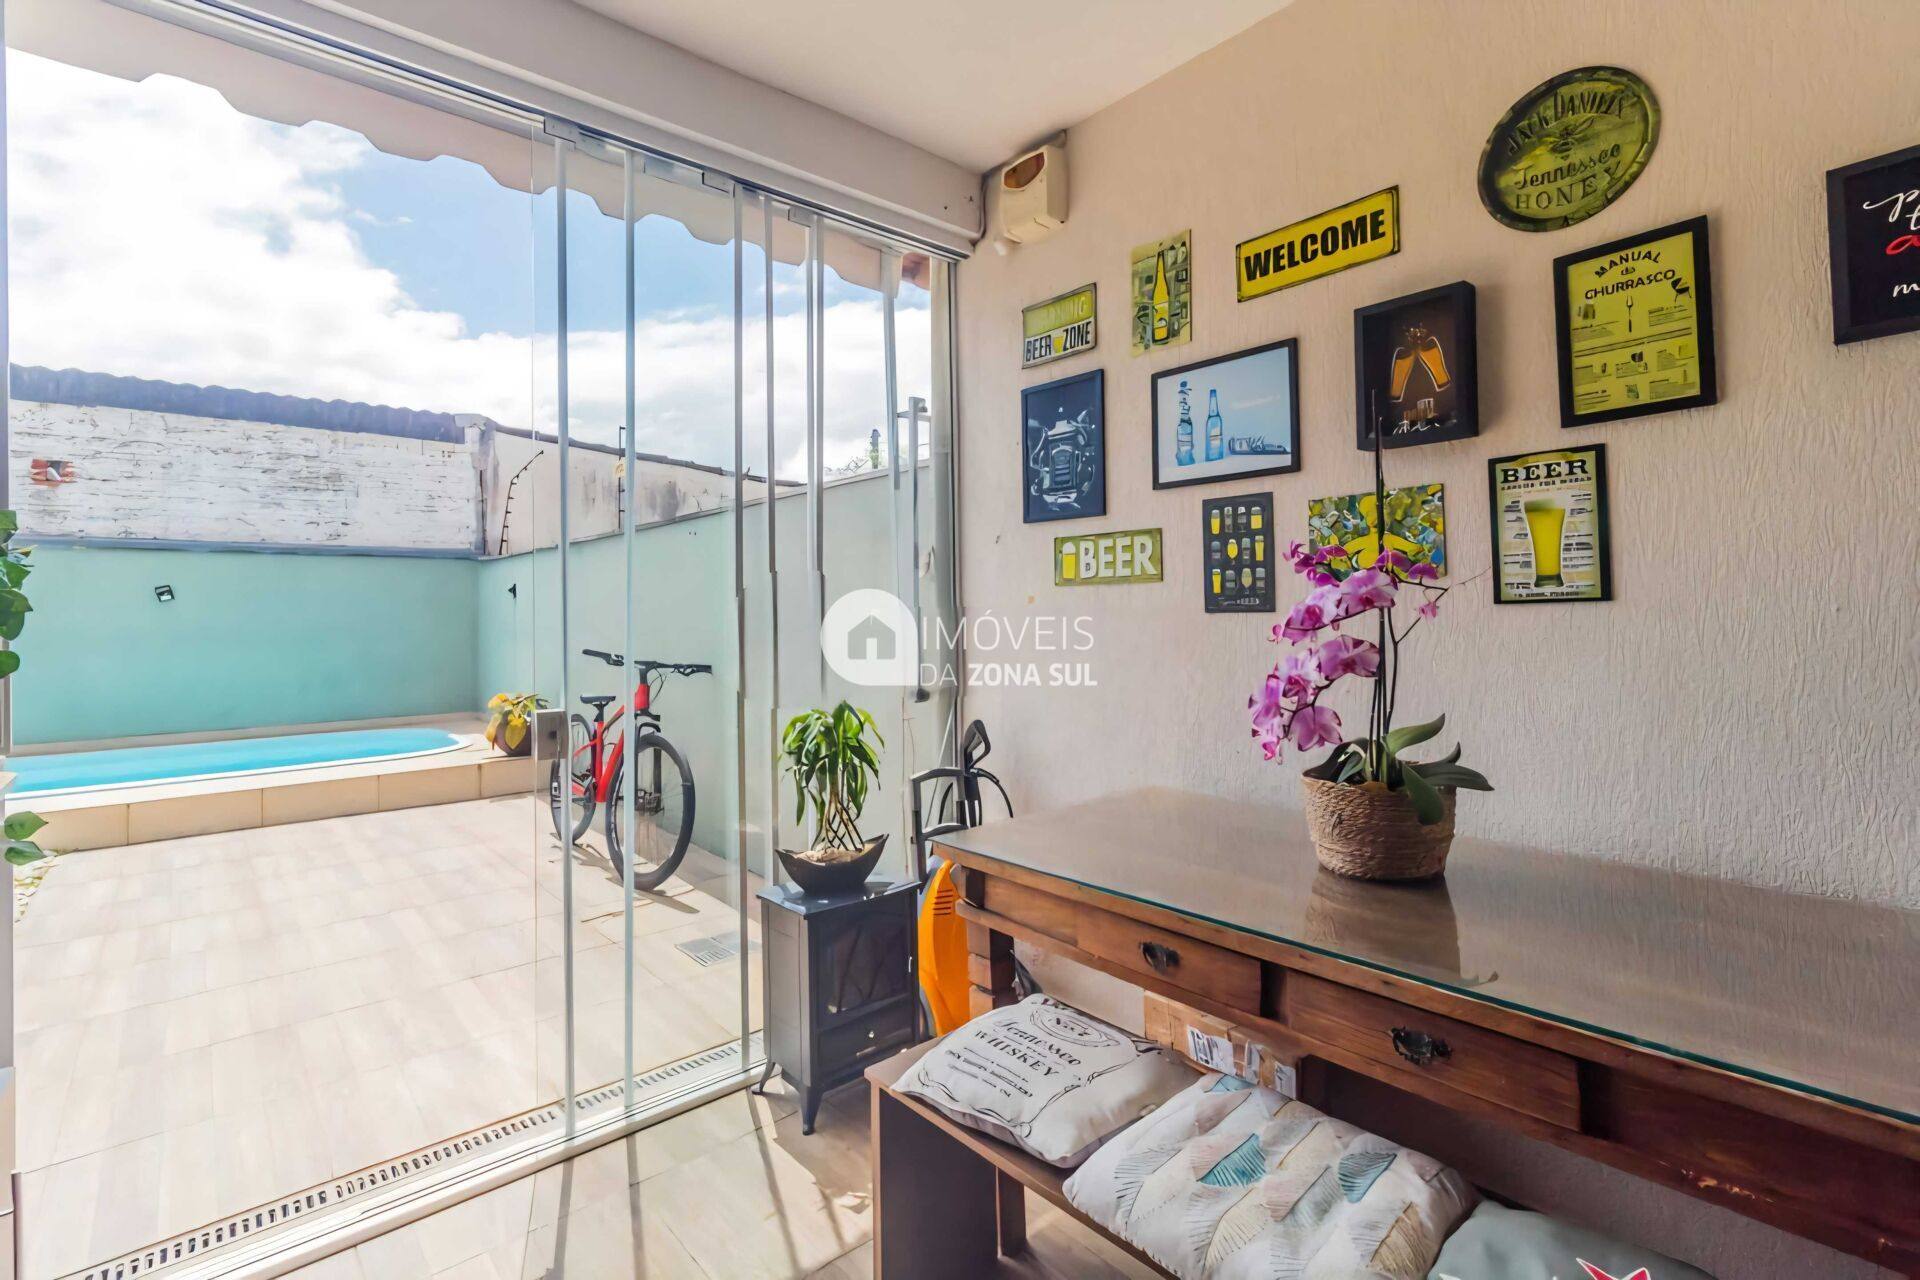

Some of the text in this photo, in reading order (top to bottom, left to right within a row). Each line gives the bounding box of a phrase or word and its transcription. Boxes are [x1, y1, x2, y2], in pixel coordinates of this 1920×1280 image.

[1515, 160, 1621, 210] HONEY
[1244, 208, 1386, 282] WELCOME
[1594, 250, 1661, 278] MANUAL
[1584, 268, 1676, 300] CHURRASCO
[1025, 320, 1092, 362] BEER ZONE
[1501, 458, 1589, 484] BEER
[1079, 535, 1158, 578] BEER
[974, 1029, 1060, 1076] WHISKEY
